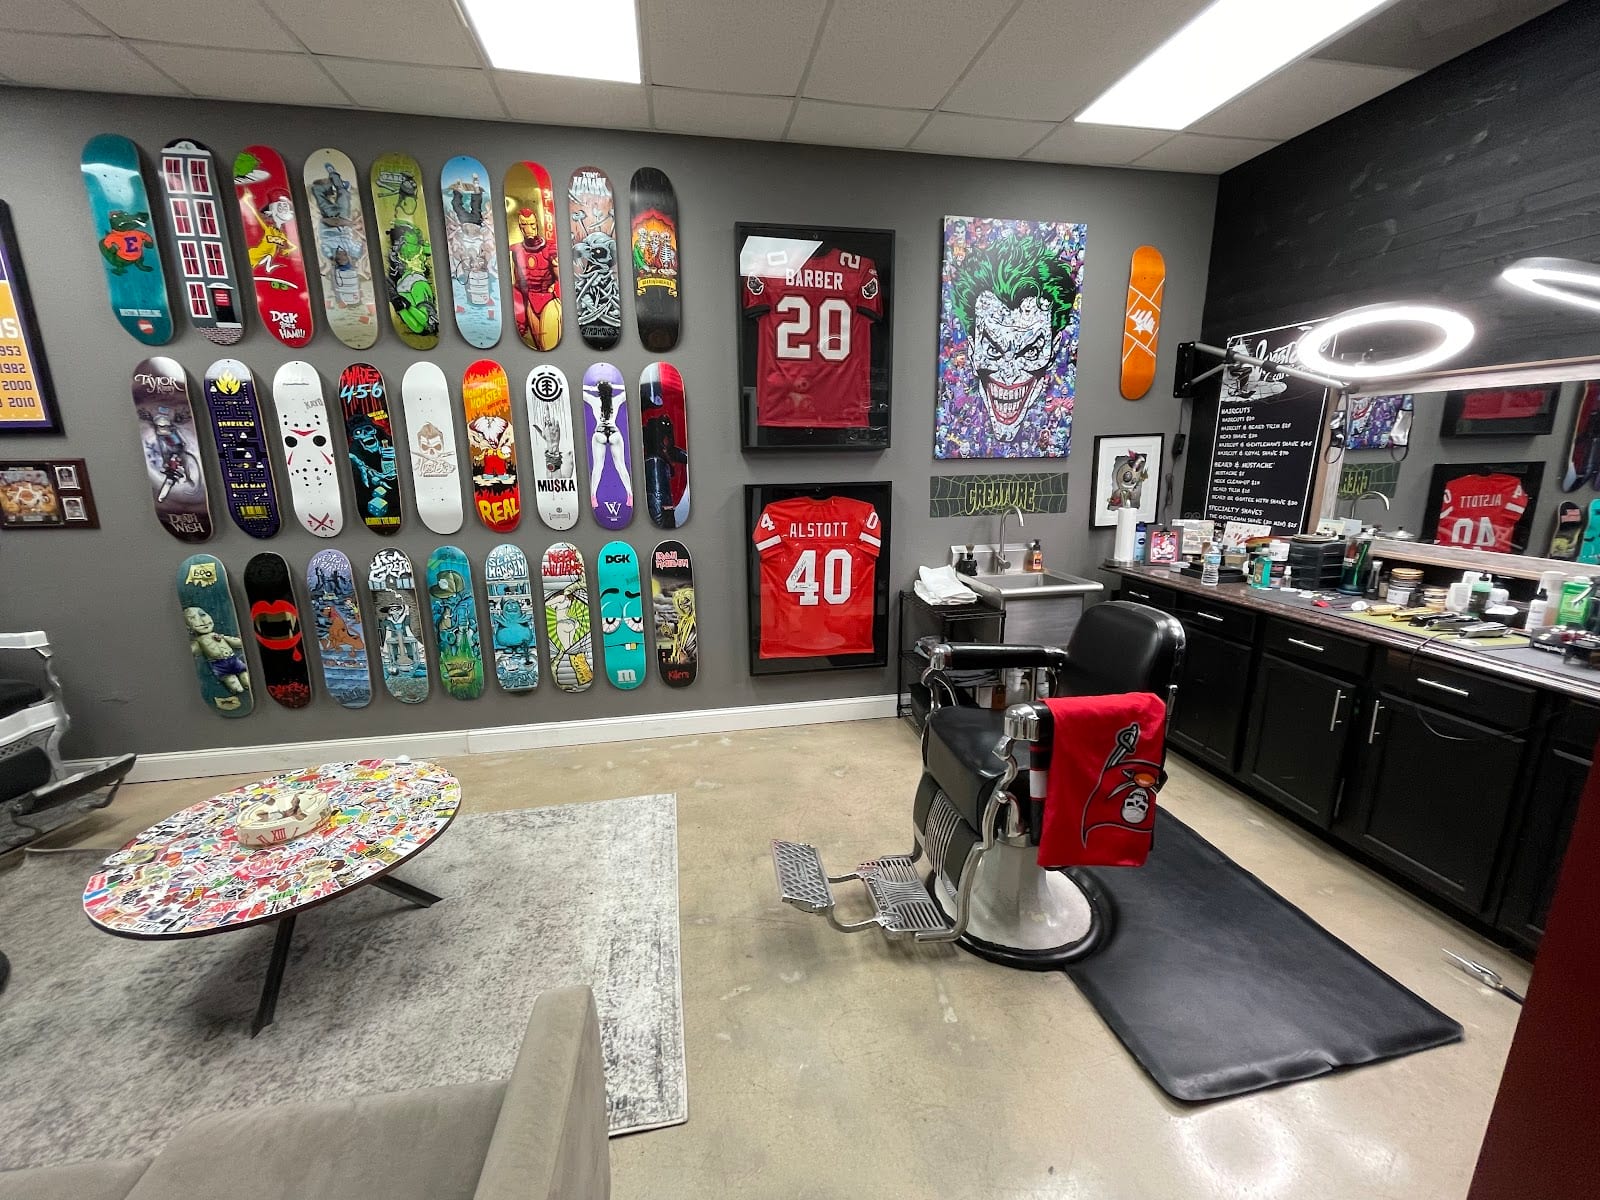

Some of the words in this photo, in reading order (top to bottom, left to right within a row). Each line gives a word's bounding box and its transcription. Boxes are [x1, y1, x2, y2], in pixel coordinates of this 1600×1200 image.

[572, 176, 612, 197] HAWK
[124, 236, 138, 253] E
[785, 268, 844, 291] BARBER
[269, 310, 299, 323] DGK
[776, 295, 852, 361] 20
[2, 380, 33, 391] 2000
[341, 366, 380, 386] WADE
[7, 397, 36, 408] 2010
[964, 481, 1037, 515] CREATURE
[478, 497, 520, 525] REAL
[1208, 505, 1240, 513] SPECIALTY
[1218, 514, 1247, 522] GENTLEMAN
[760, 512, 776, 532] 4
[789, 522, 849, 538] ALSTOTT
[866, 511, 879, 530] 0
[488, 552, 524, 567] SLASH
[488, 559, 524, 578] HANSEN
[605, 554, 630, 564] DGK
[785, 548, 853, 606] 40
